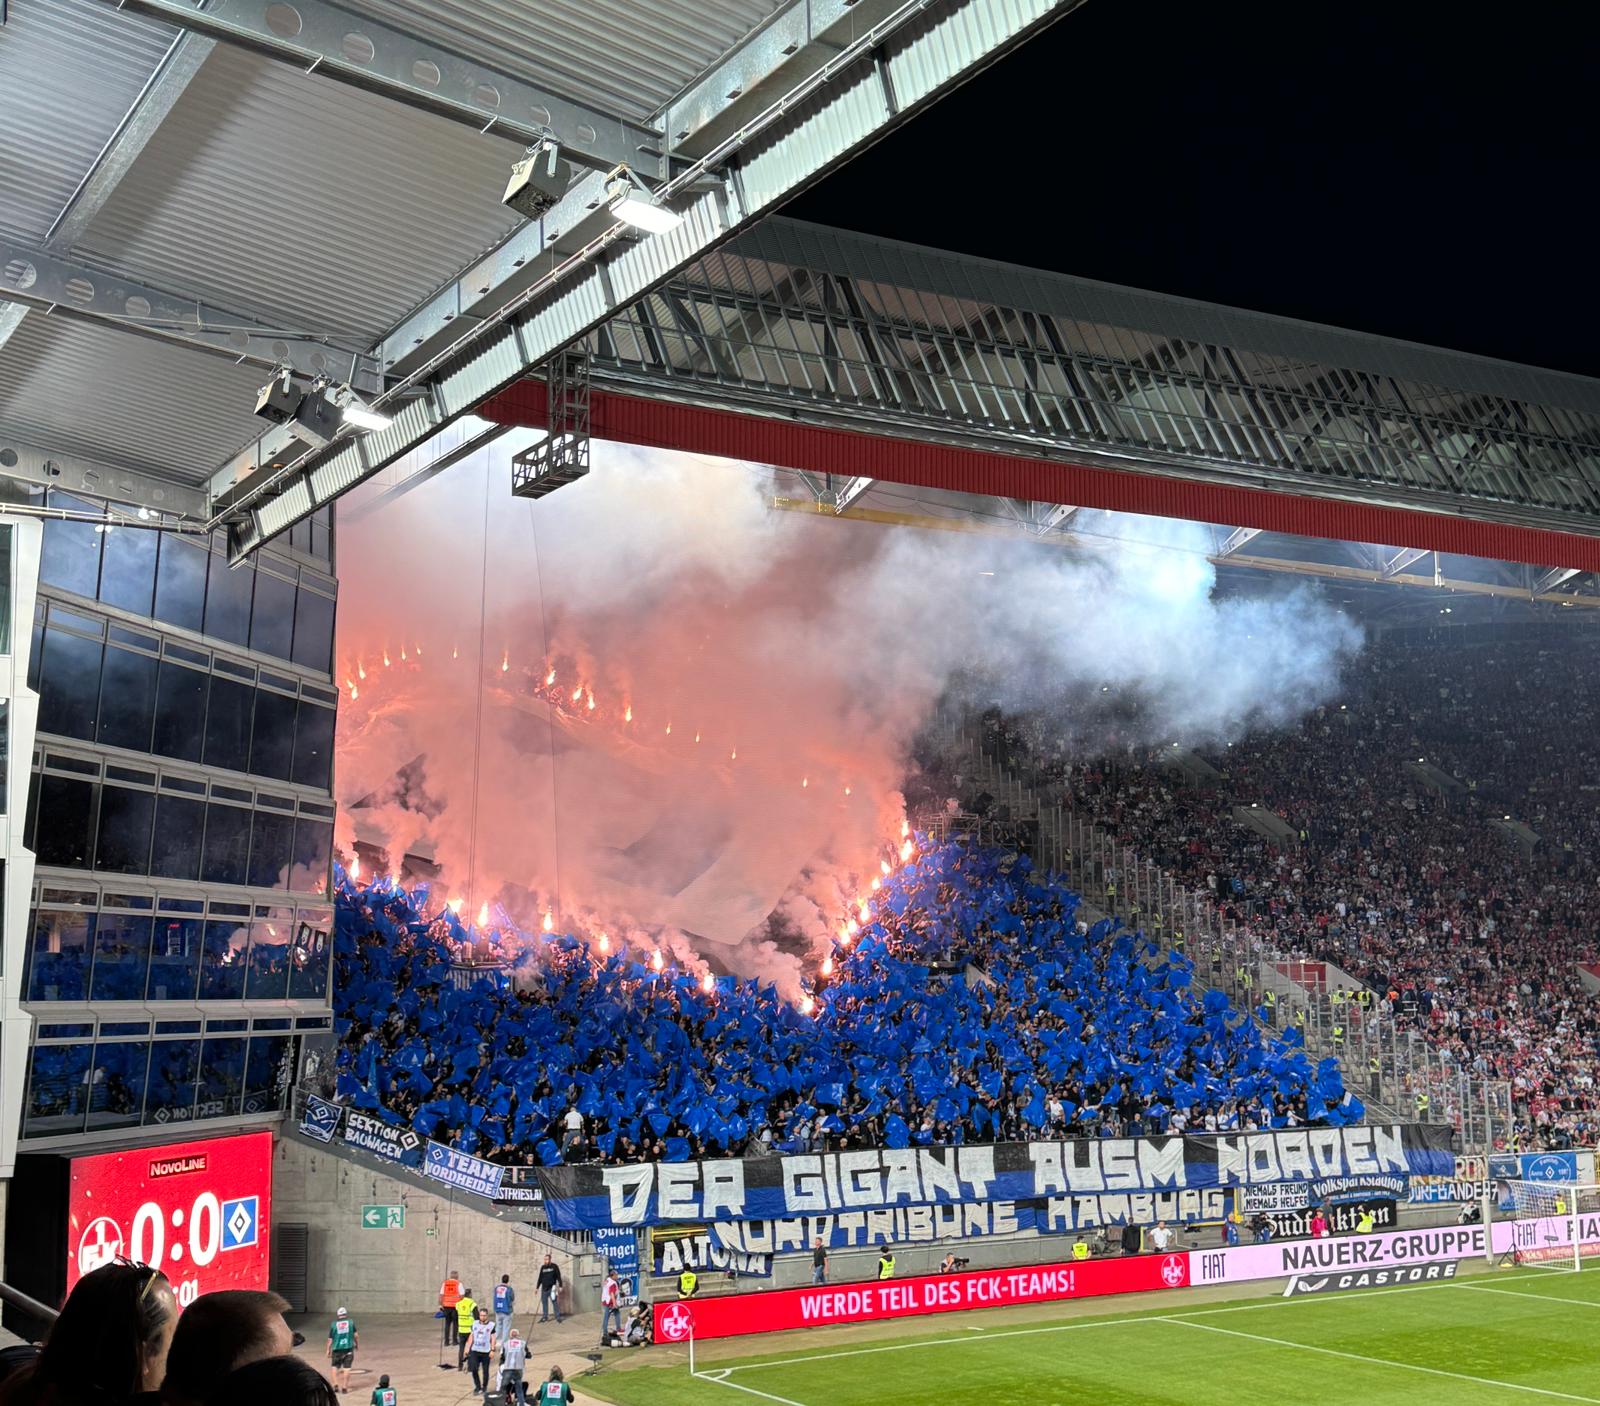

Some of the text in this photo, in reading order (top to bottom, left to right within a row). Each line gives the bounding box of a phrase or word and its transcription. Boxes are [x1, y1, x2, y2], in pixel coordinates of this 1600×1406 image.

[345, 1127, 403, 1159] BAUWAGEN
[448, 1150, 498, 1182] TEAM
[602, 1126, 1409, 1223] DER GIGANT AUSM NORDEN
[1245, 1183, 1308, 1198] NIEMALS FREUND
[1246, 1198, 1278, 1210] NIEMALS
[1048, 1188, 1225, 1231] HAMBURG
[1517, 1223, 1537, 1247] FIAT
[1567, 1217, 1600, 1241] FIA
[662, 1236, 766, 1275] ALTONA
[1202, 1253, 1226, 1280] FIAT
[1282, 1230, 1485, 1271] NAUERZ-GRUPPE
[1338, 1263, 1457, 1289] CASTORE
[800, 1269, 1075, 1320] WERDE TEIL DES FCK-TEAMS!
